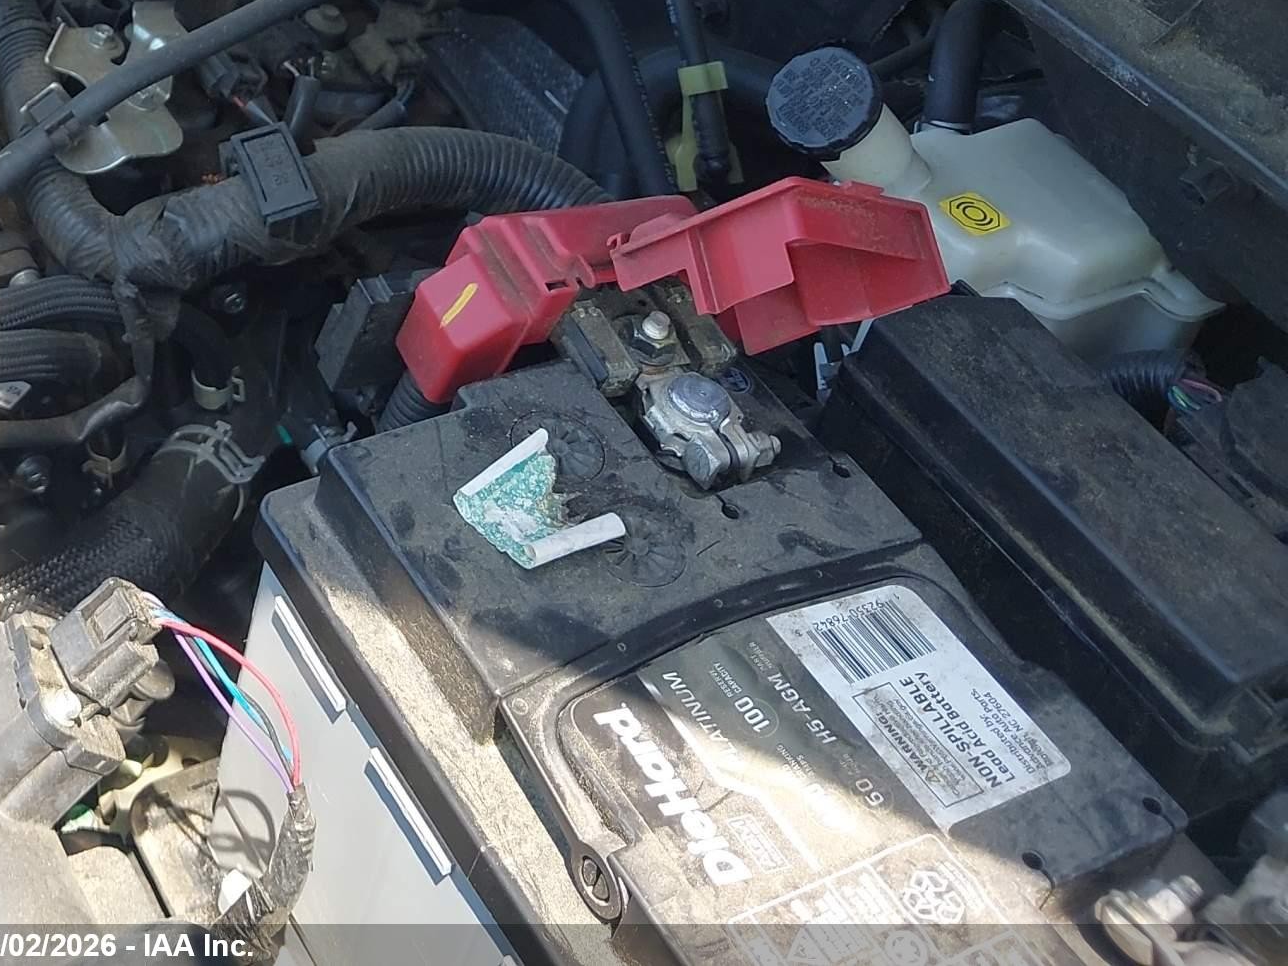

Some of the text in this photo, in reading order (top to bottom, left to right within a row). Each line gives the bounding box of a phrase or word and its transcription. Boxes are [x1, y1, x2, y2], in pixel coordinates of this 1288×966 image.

[812, 612, 848, 632] 76842
[848, 599, 884, 615] 92350
[713, 662, 742, 694] CAPACITY
[767, 672, 837, 744] H5-AGM
[914, 671, 960, 720] Battery
[983, 692, 1011, 719] 27604
[662, 672, 741, 759] LATINUM
[734, 696, 770, 733] 100
[991, 712, 1012, 733] Auto
[1008, 718, 1023, 732] NC
[875, 712, 928, 771] WARNING:
[899, 676, 1002, 788] NON-SPILLABLE
[955, 721, 987, 748] Acid
[979, 713, 1036, 774] Distributed by:
[981, 749, 1016, 782] Lead
[1011, 734, 1045, 769] Advance
[592, 708, 753, 885] DieHard
[855, 778, 884, 806] 60
